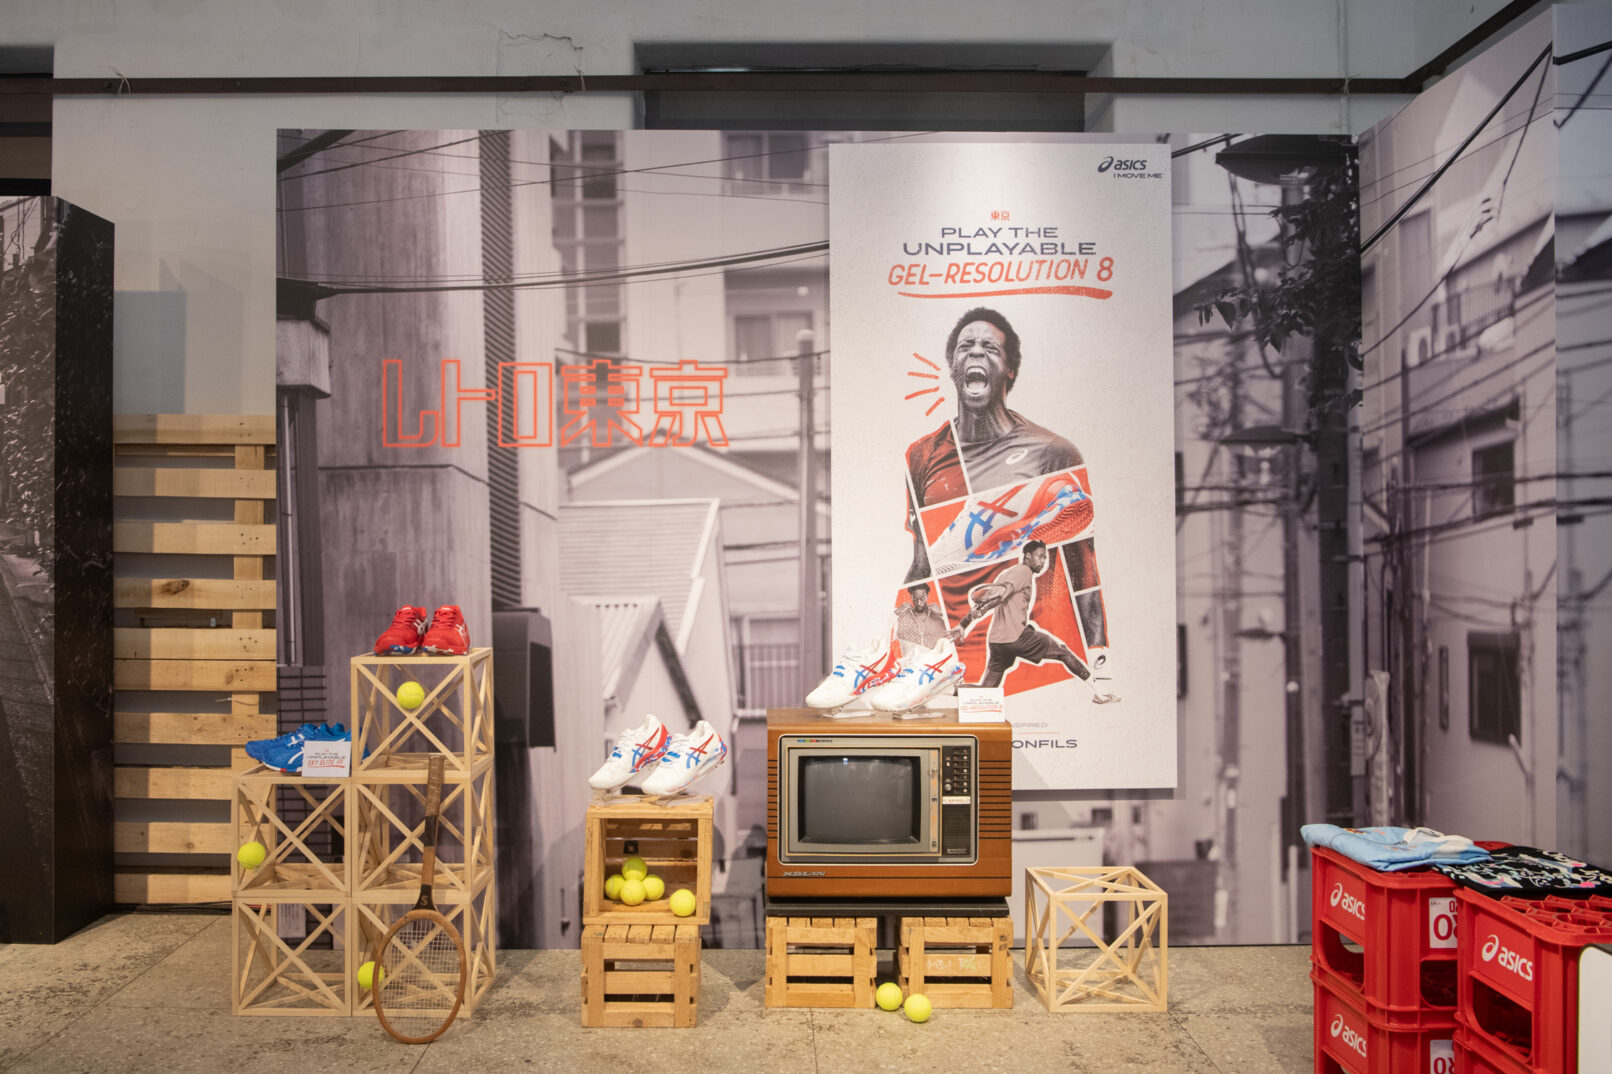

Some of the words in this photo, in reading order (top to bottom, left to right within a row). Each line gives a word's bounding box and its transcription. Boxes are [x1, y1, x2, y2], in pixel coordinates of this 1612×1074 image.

[990, 210, 1010, 221] 東京
[941, 227, 1003, 239] PLAY
[1008, 227, 1059, 239] THE
[903, 242, 1097, 256] UNPLAYABLE
[888, 258, 1088, 286] GEL-RESOLUTION
[1096, 256, 1114, 282] 8
[1498, 948, 1533, 982] asics
